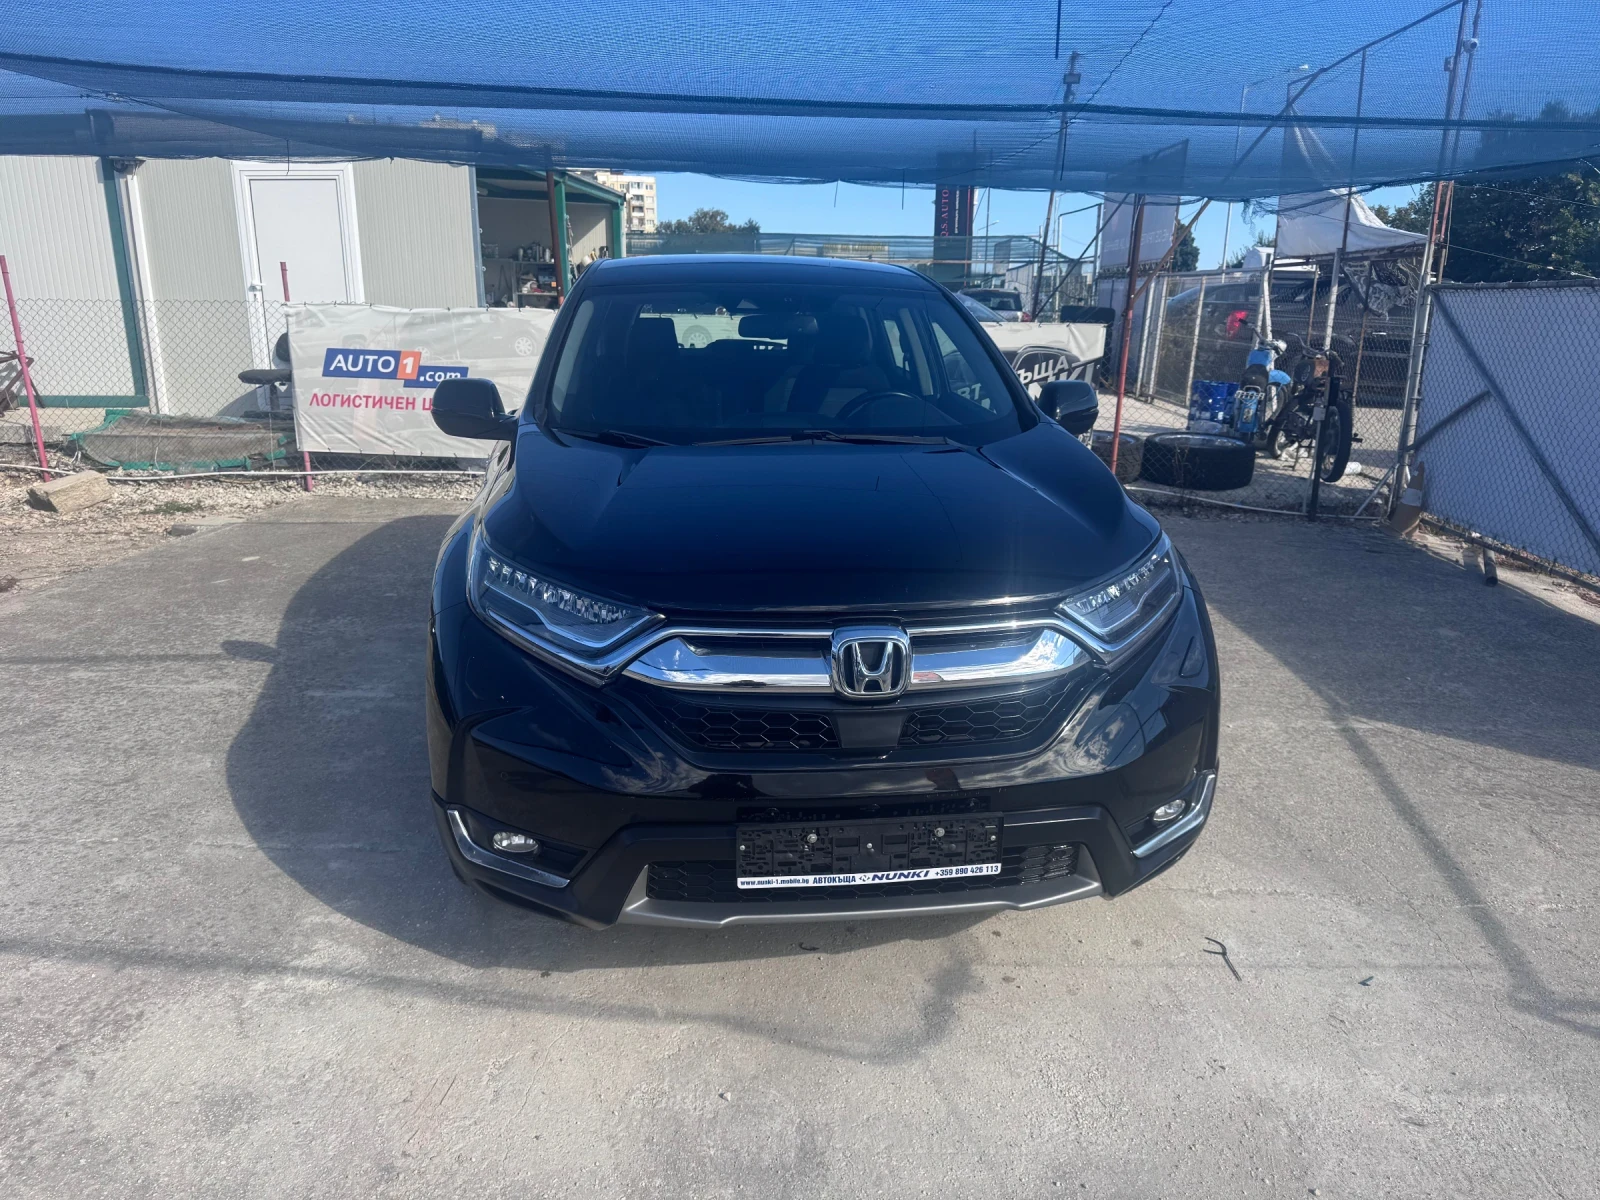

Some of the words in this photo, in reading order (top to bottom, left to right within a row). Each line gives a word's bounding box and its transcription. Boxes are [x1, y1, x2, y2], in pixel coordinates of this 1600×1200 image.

[941, 189, 949, 219] AUTO
[309, 393, 416, 411] ЛОГИСТИЧЕН
[740, 877, 810, 886] www.nunki-1.mobile.bg
[812, 875, 857, 885] АВТОКЪЩА
[871, 870, 930, 881] NUNKI
[934, 868, 953, 876] +359
[955, 867, 968, 875] 890
[969, 866, 984, 874] 426
[985, 865, 999, 873] 113
